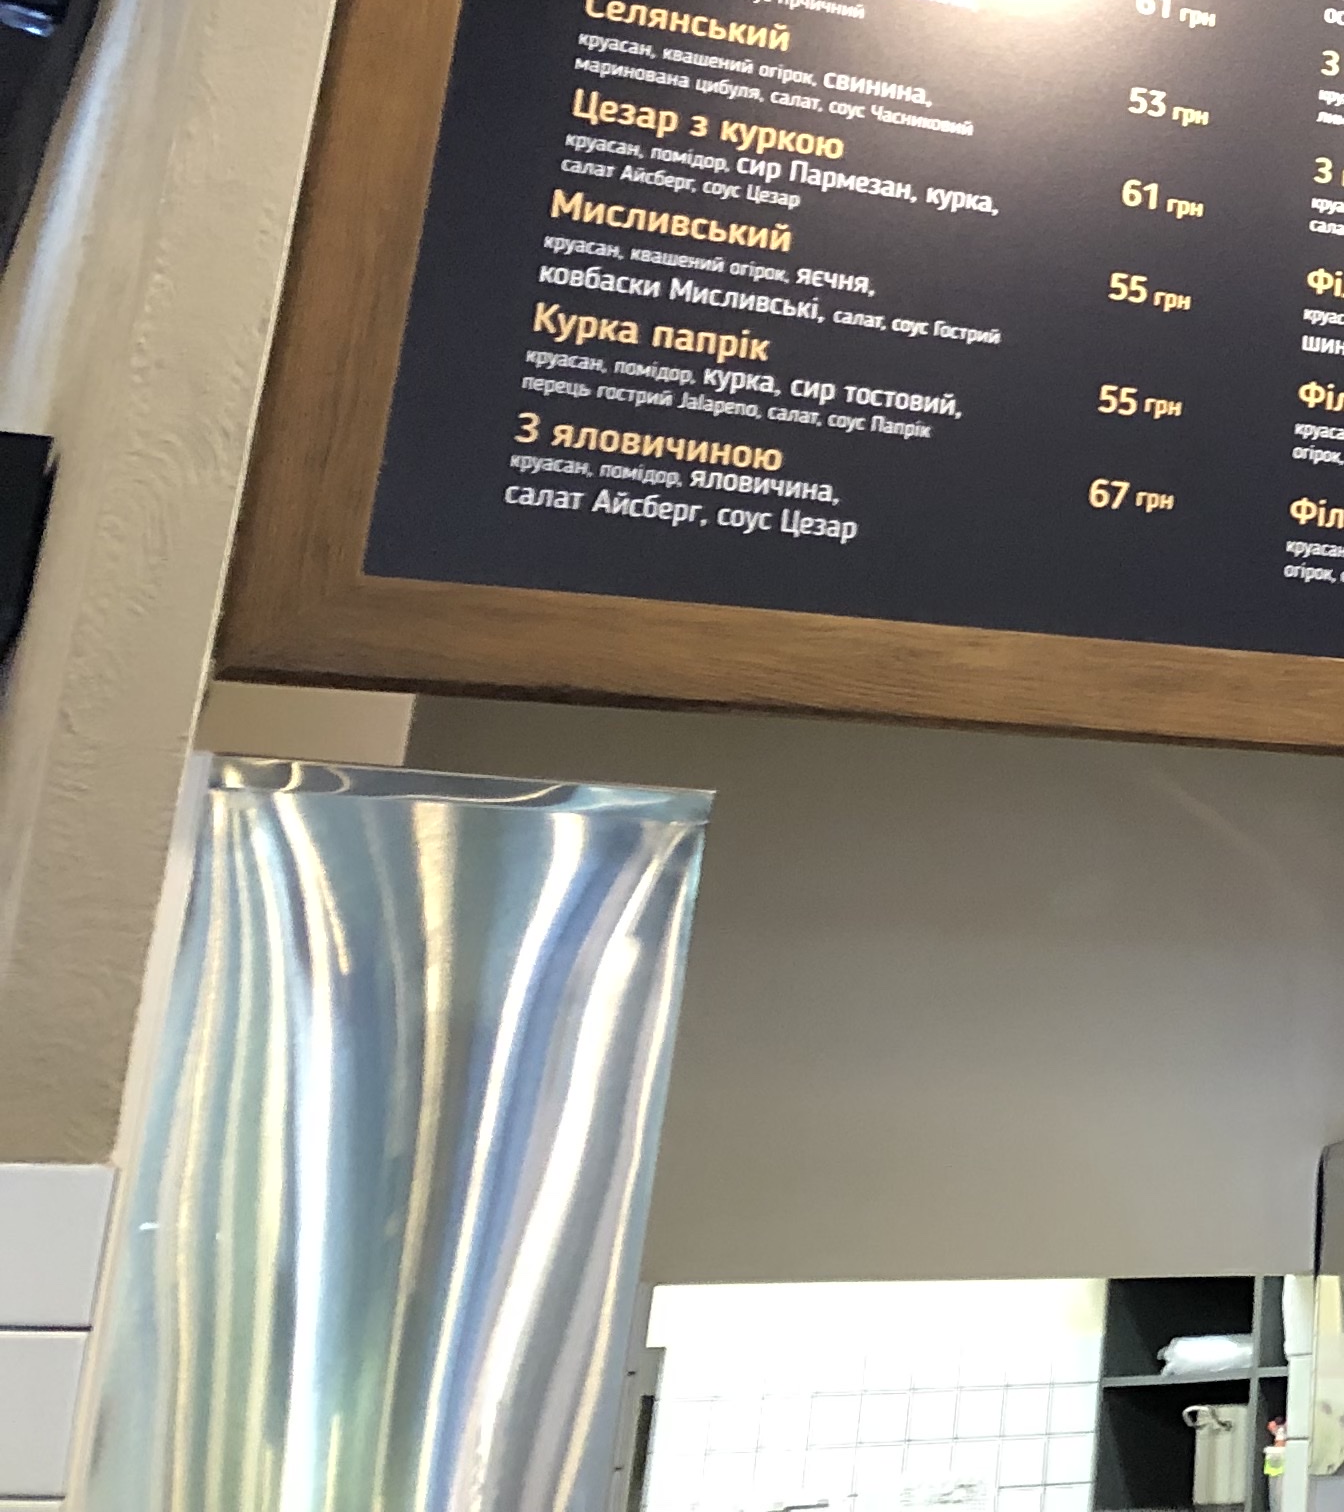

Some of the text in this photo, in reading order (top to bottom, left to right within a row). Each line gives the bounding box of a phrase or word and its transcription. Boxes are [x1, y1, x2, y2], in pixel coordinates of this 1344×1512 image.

[1178, 7, 1216, 29] грн
[1320, 49, 1340, 76] З
[822, 71, 933, 108] свинина,
[1127, 86, 1209, 127] 53 грн
[572, 87, 844, 159] Цезар з куркою
[736, 156, 999, 216] сир Пармезан, курка,
[1313, 156, 1332, 184] З
[1121, 178, 1203, 219] 61 грн
[550, 188, 791, 252] Мисливський
[539, 265, 825, 323] ковбаски Мисливські,
[795, 267, 875, 297] яєчня,
[1108, 271, 1191, 312] 55 грн
[533, 301, 770, 363] Курка папрік
[703, 368, 962, 419] курка, сир тостовий,
[1097, 384, 1182, 419] 55 грн
[515, 411, 782, 471] З яловичиною
[689, 469, 839, 505] яловичина,
[1088, 478, 1174, 512] 67 грн
[504, 485, 857, 544] салат Айсберг, соус Цезар
